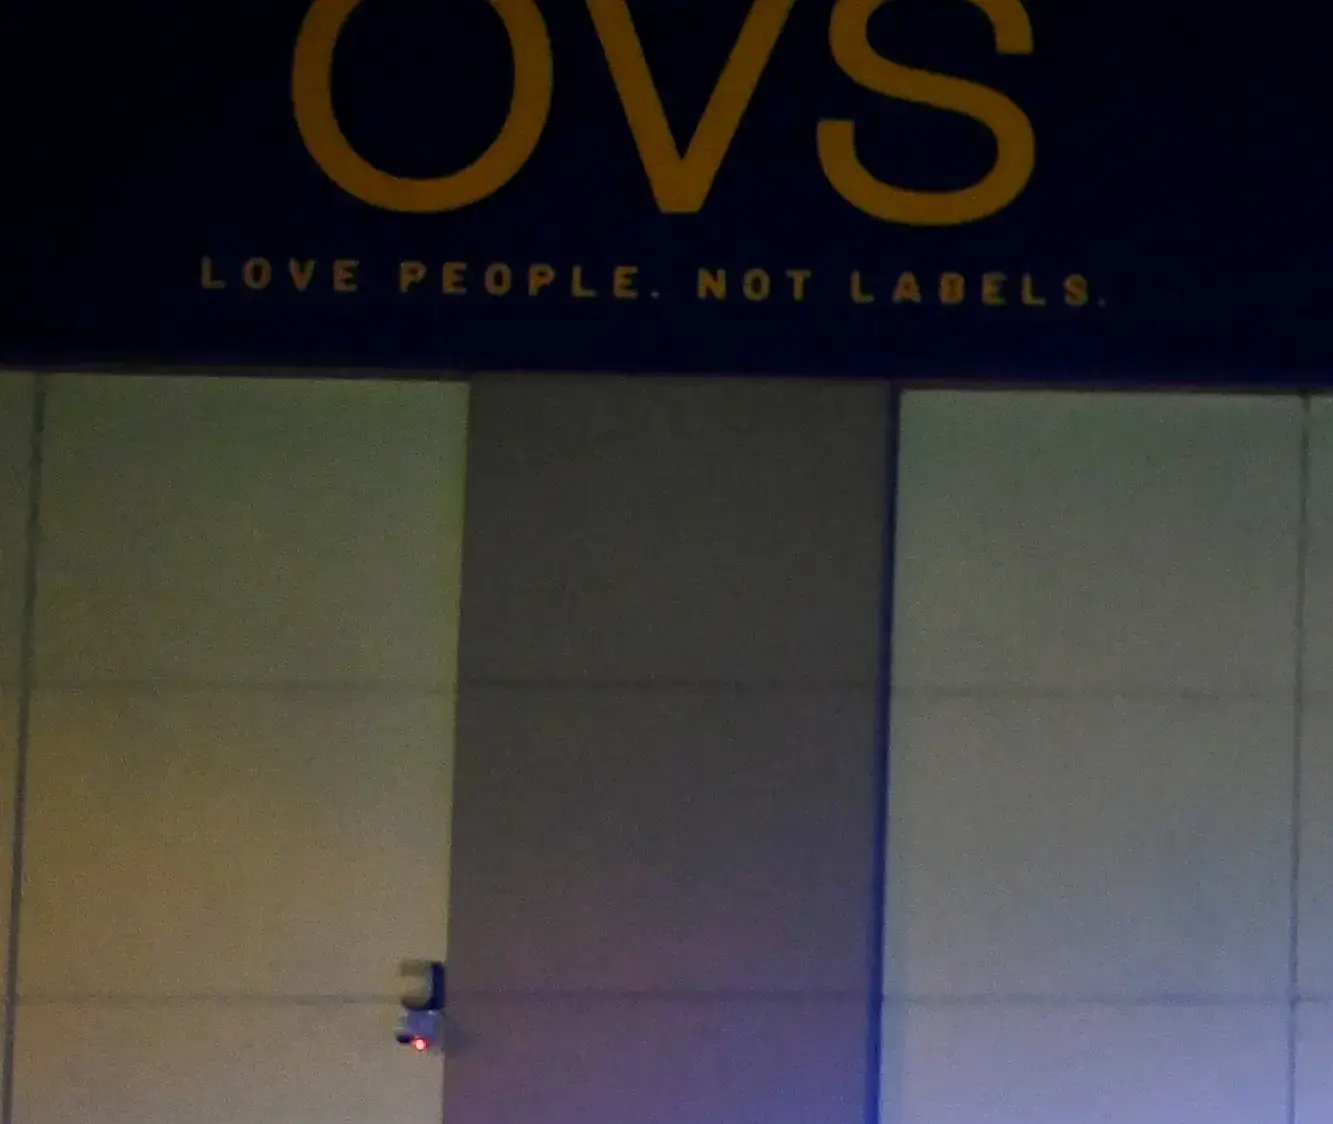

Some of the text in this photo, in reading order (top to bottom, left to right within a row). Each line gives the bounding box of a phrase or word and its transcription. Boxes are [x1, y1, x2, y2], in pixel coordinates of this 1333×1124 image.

[291, 0, 1036, 226] OVS
[201, 256, 1107, 307] LOVE PEOPLE. NOT LABELS.
